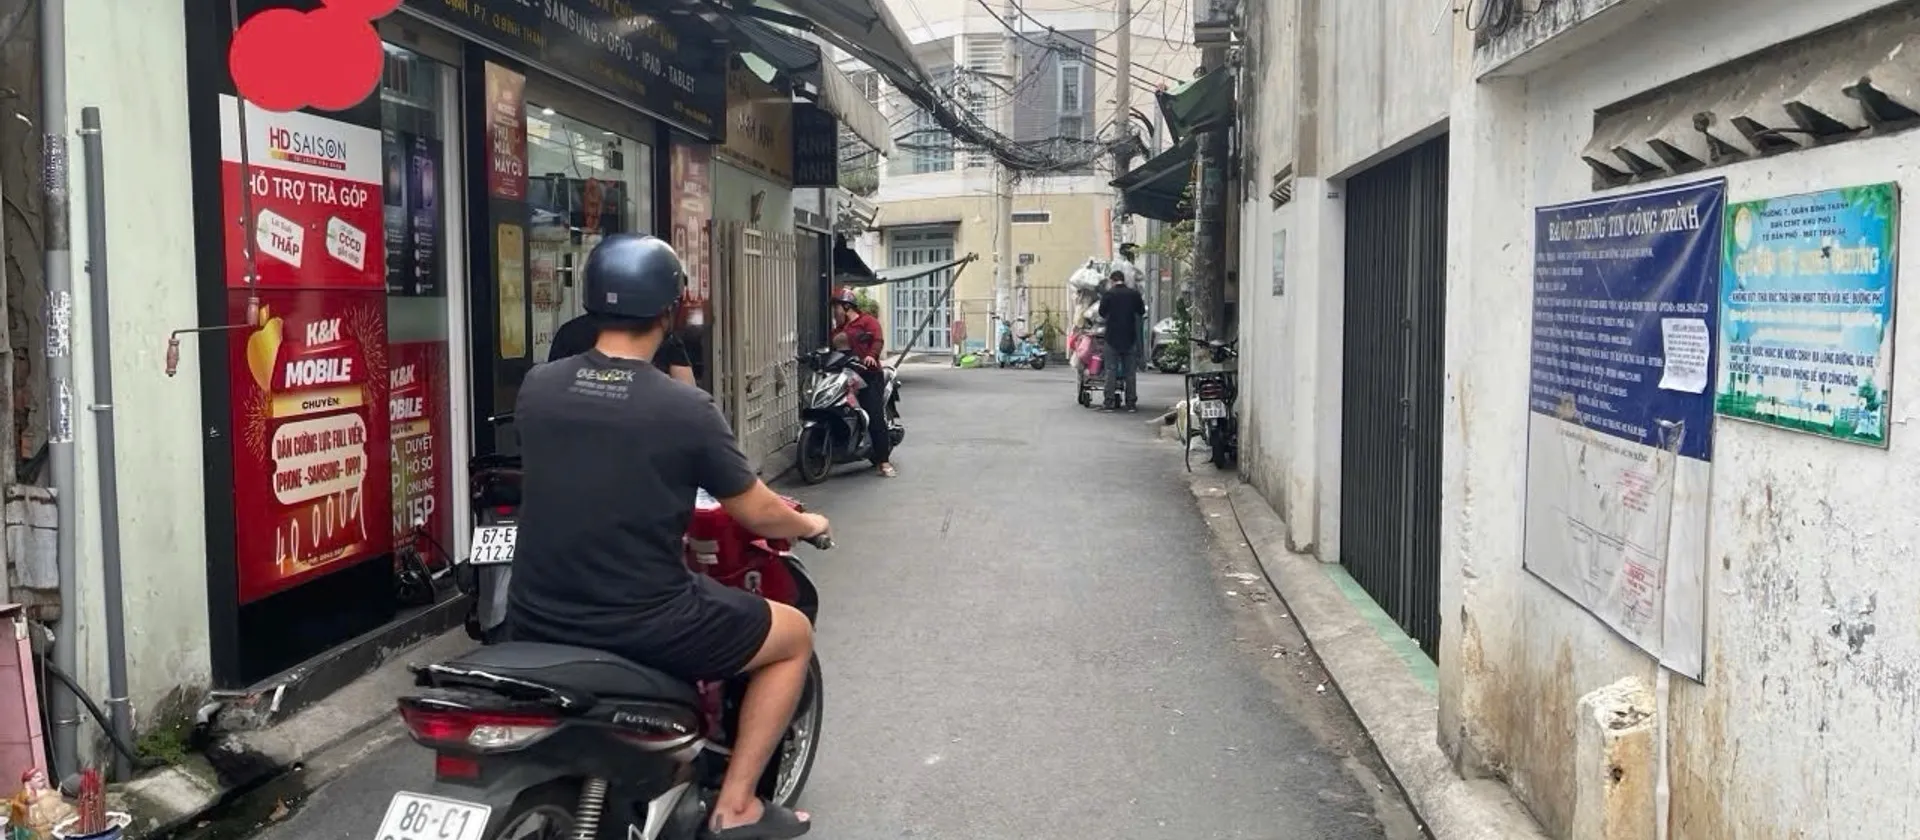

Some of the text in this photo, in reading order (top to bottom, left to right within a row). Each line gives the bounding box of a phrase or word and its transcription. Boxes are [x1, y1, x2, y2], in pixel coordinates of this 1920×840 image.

[545, 0, 598, 42] SAMSUNG
[668, 65, 695, 94] TABLET
[272, 176, 305, 205] TRỢ
[340, 184, 368, 208] GÓP
[1608, 214, 1626, 236] TIN
[1660, 200, 1700, 233] TRÌNH
[271, 232, 299, 256] THẤP
[339, 232, 361, 252] CCCD
[306, 318, 342, 347] K&K
[285, 357, 353, 389] MOBILE
[390, 397, 422, 422] OBILE
[276, 468, 302, 493] IPHONE
[345, 455, 361, 477] OPPO
[482, 528, 517, 544] 67-E
[474, 545, 513, 561] 212.2
